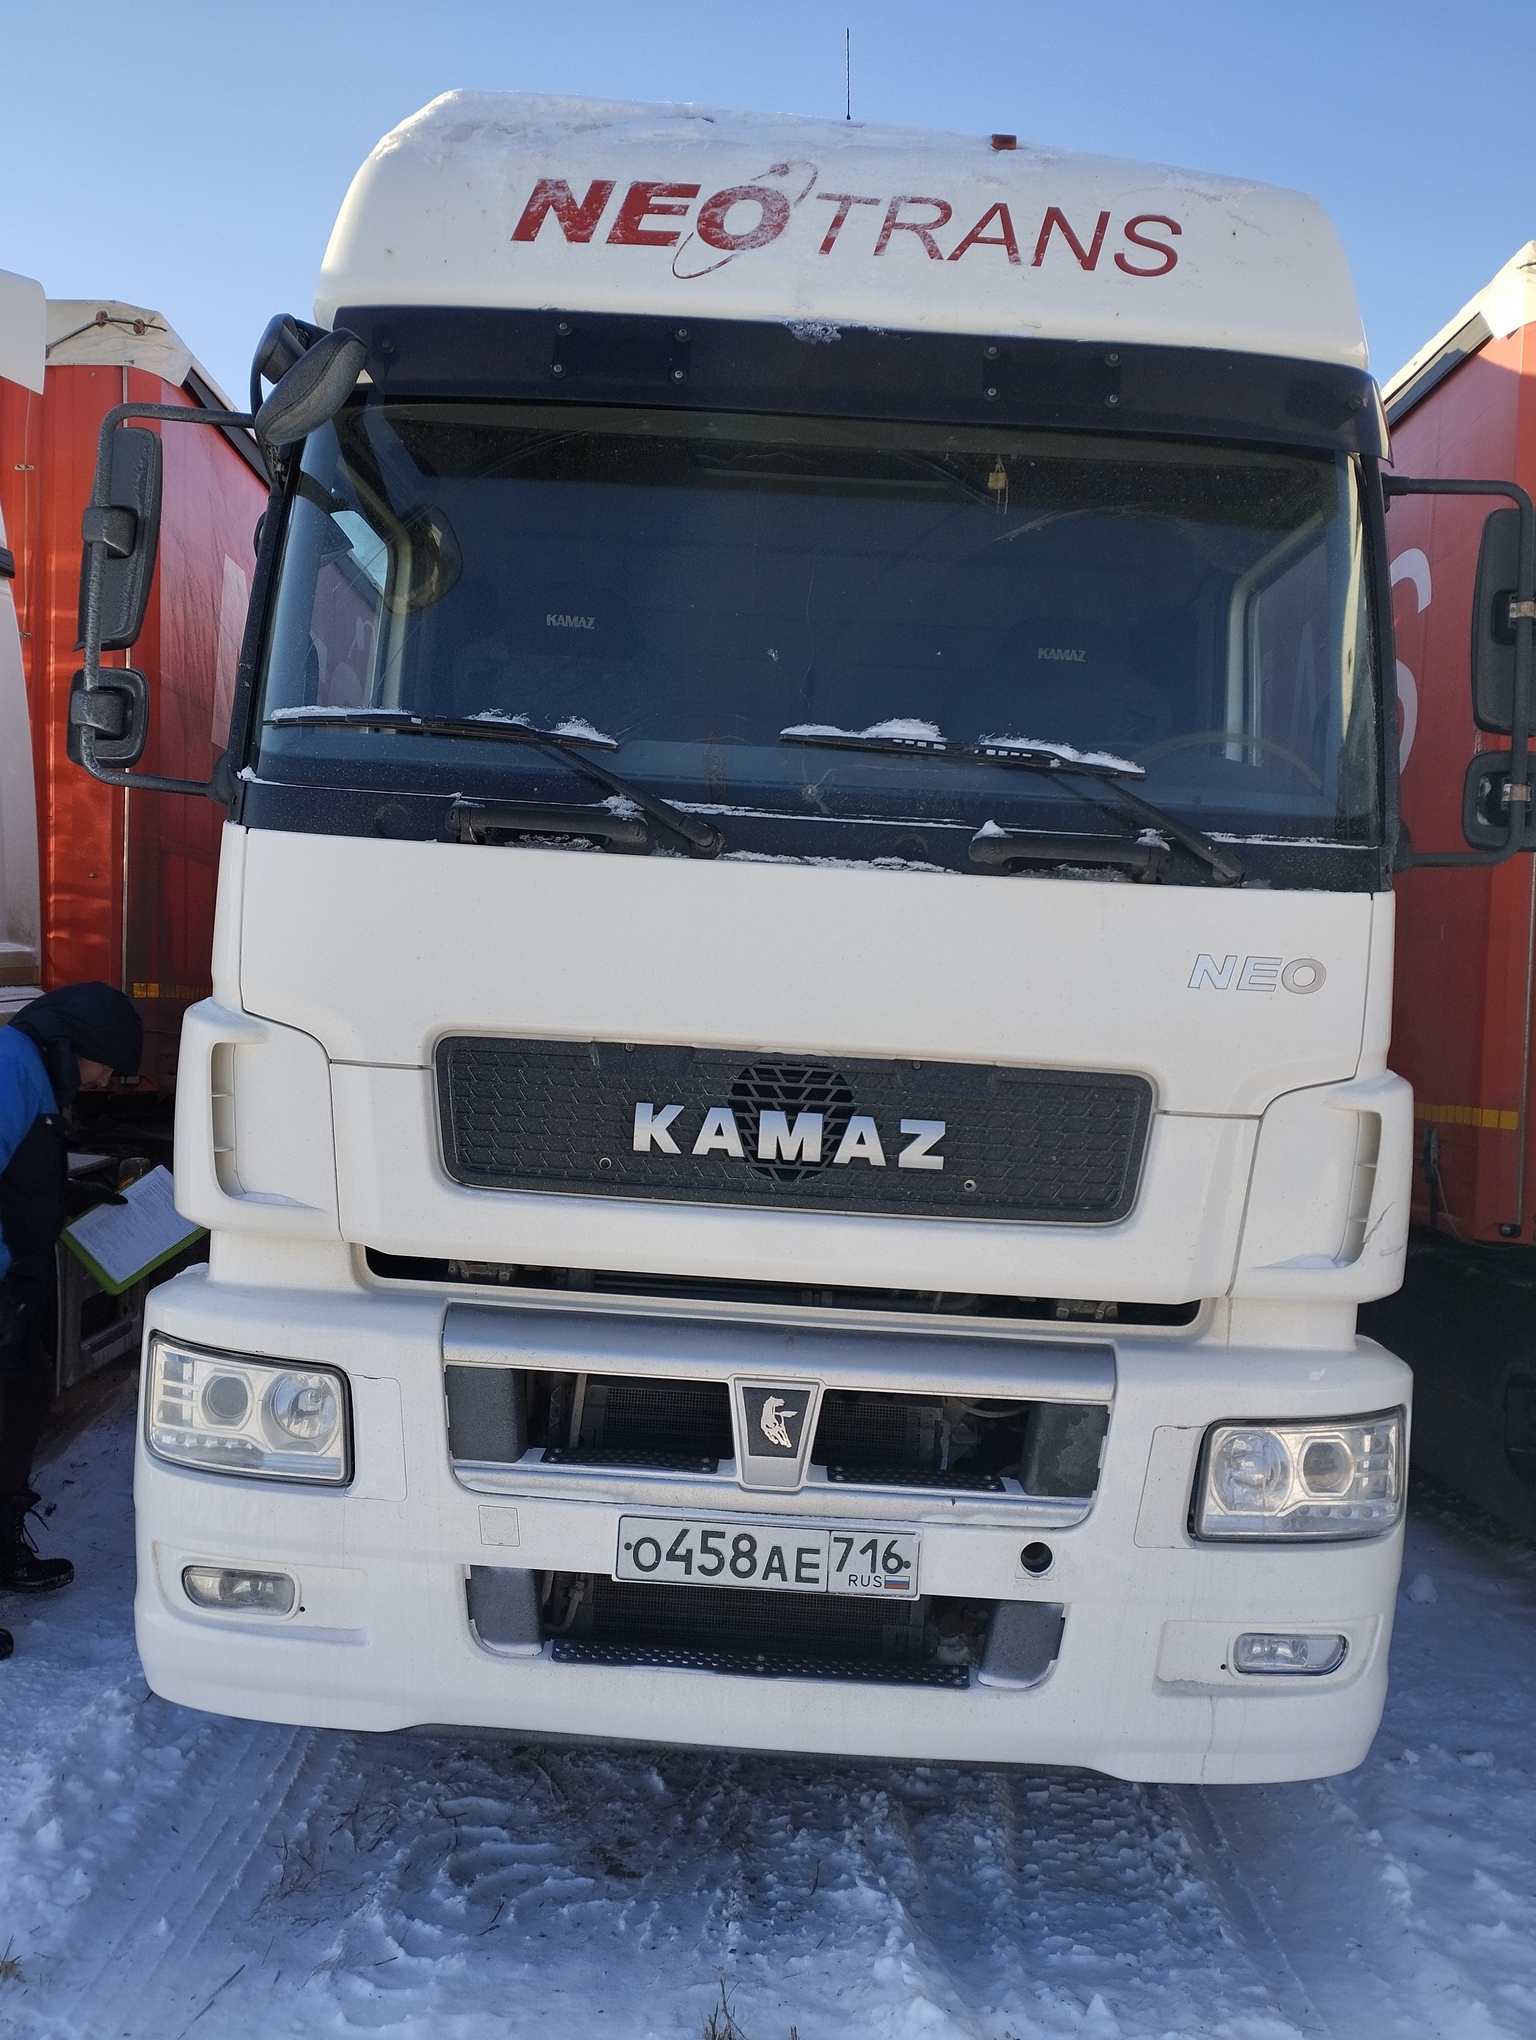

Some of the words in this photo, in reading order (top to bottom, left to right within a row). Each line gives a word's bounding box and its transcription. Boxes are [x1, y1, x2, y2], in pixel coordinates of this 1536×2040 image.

[546, 613, 596, 630] KAMAZ
[1038, 647, 1087, 662] KAMAZ
[1187, 953, 1327, 995] NEO
[632, 1101, 947, 1171] KAMAZ
[833, 1536, 904, 1575] 716
[848, 1573, 883, 1588] RUS
